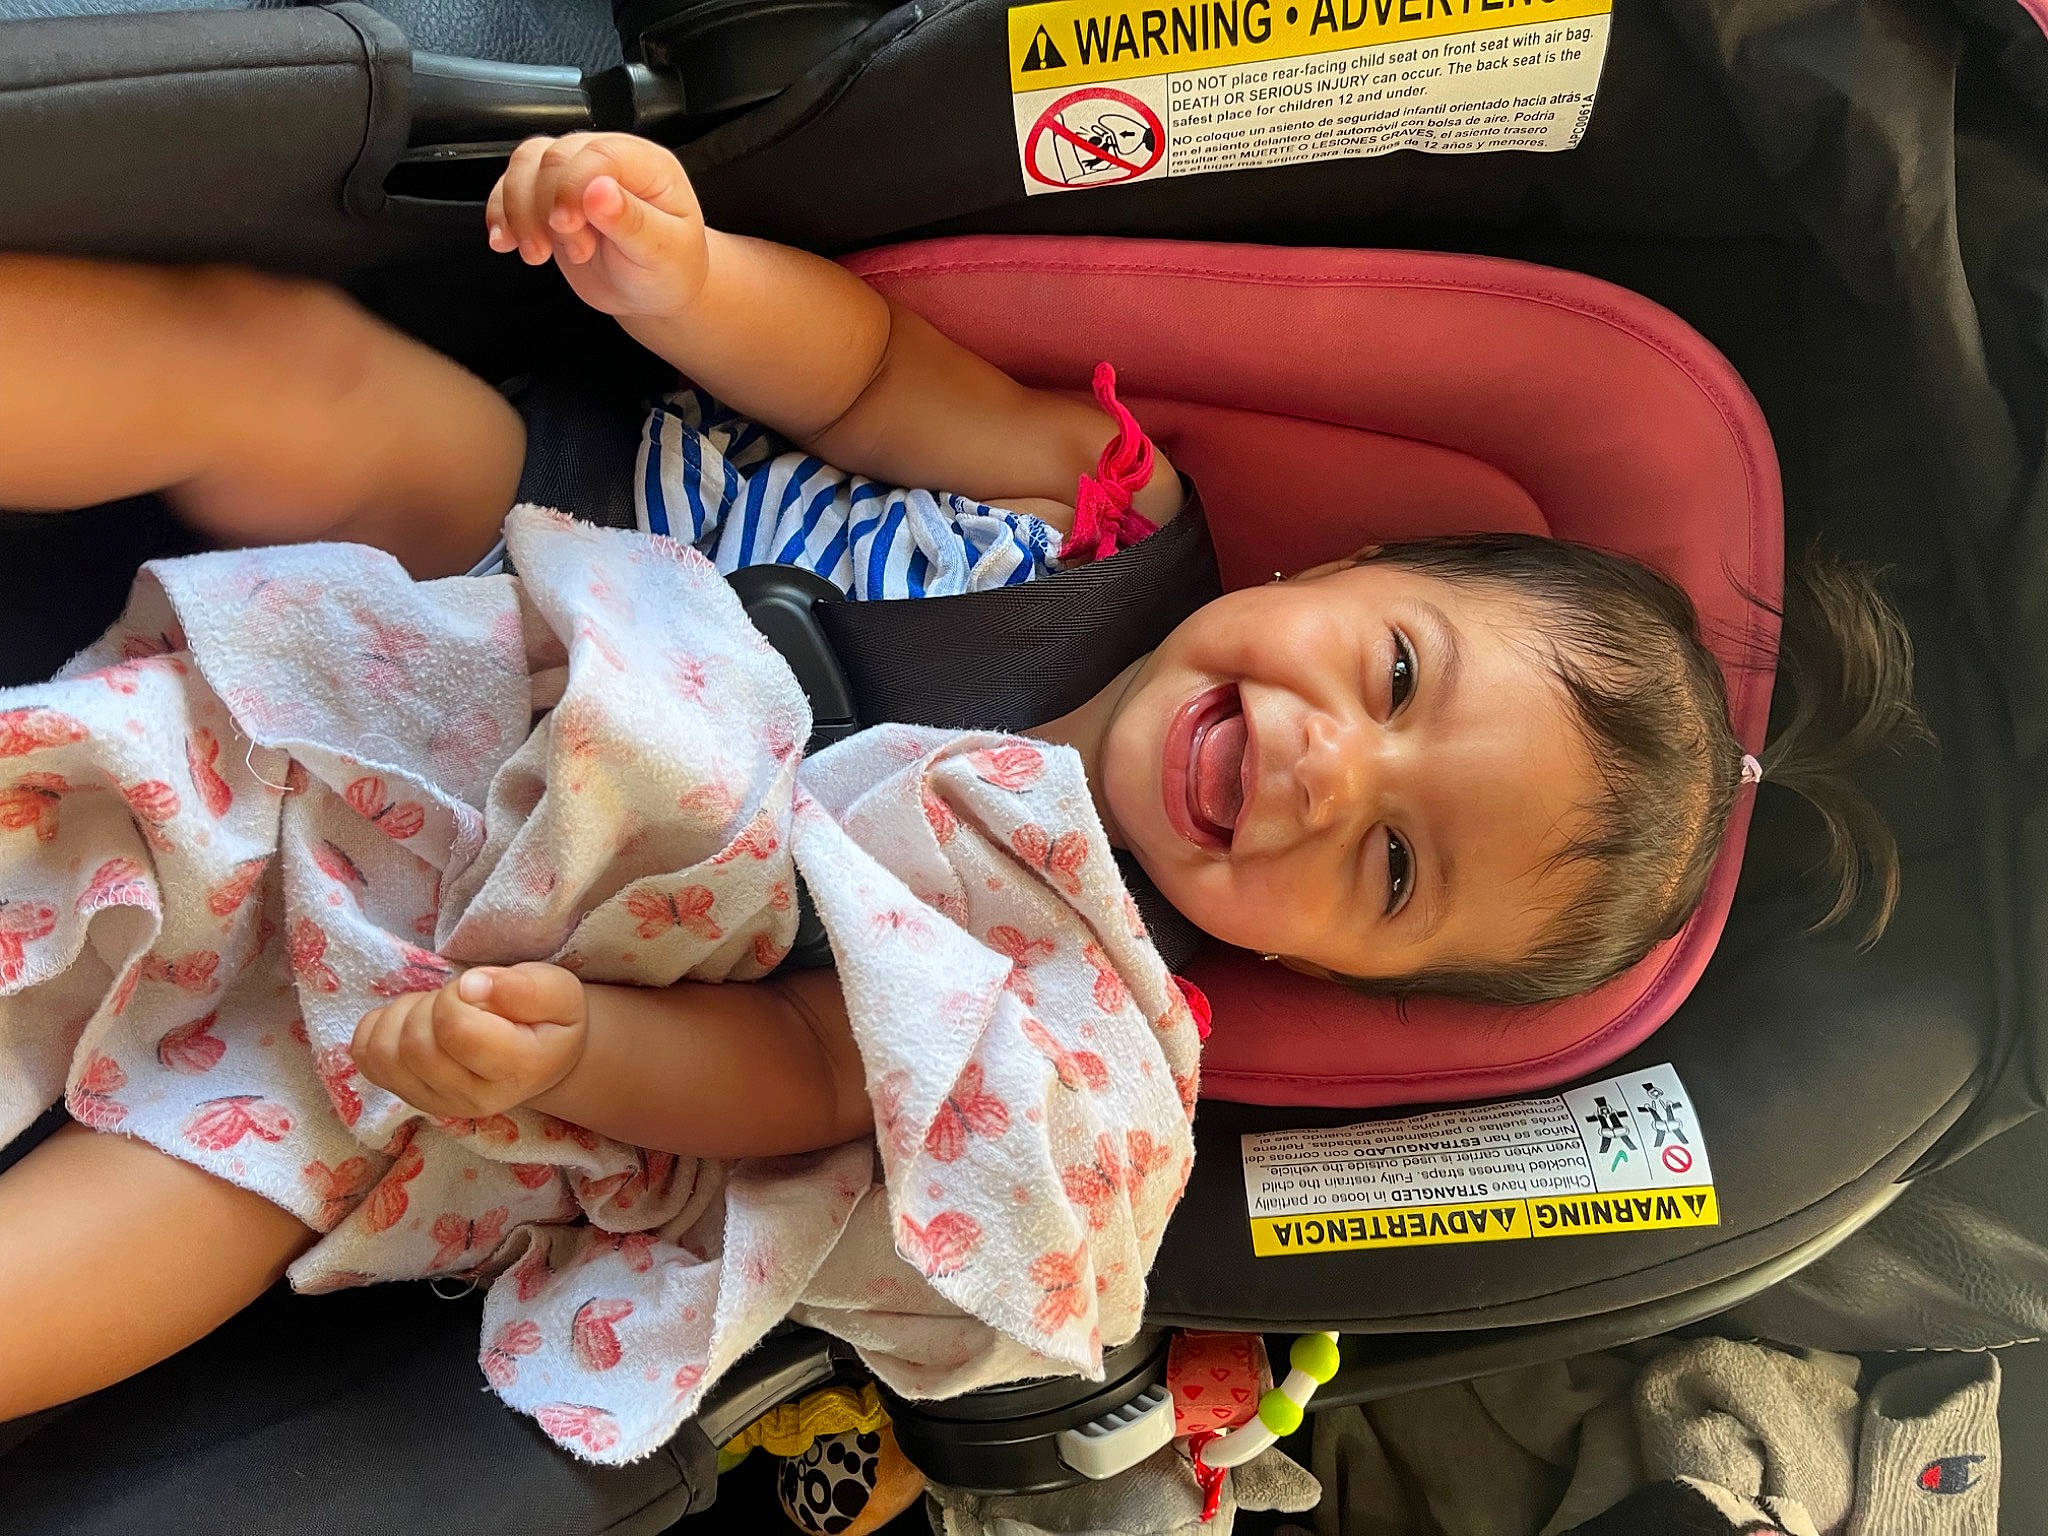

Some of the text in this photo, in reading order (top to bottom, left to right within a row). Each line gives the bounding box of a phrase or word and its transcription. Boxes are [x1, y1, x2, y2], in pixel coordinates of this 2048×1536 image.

[1073, 0, 1272, 65] WARNING
[1172, 27, 1593, 94] DO NOT place rear-facing child seat on front seat with air bag.
[1172, 48, 1581, 112] DEATH OR SERIOUS INJURY can occur. The back seat is the
[1172, 86, 1428, 127] safest place for children 12 and under.
[1173, 135, 1192, 146] NO
[1196, 130, 1246, 143] coloque
[1249, 127, 1265, 136] un
[1269, 120, 1314, 133] asiento
[1318, 117, 1333, 127] de
[1336, 108, 1400, 125] seguridad
[1403, 104, 1446, 116] infantil
[1449, 98, 1510, 113] orientado
[1550, 91, 1581, 104] atrás
[1172, 150, 1187, 158] en
[1190, 146, 1201, 155] el
[1204, 141, 1250, 153] asiento
[1253, 134, 1311, 147] delantero
[1314, 129, 1333, 139] del
[1401, 119, 1425, 127] con
[1427, 118, 1462, 128] bolsa
[1465, 115, 1481, 125] de
[1483, 114, 1510, 124] aire.
[1323, 1149, 1349, 1157] con
[1353, 1137, 1481, 1156] ESTRANGULADO
[1483, 1133, 1511, 1143] han
[1514, 1131, 1530, 1140] se
[1245, 1155, 1266, 1164] del
[1262, 1156, 1586, 1193] buckled harness straps. Fully restrain the child
[1266, 1141, 1580, 1176] even when carrier is used outside the vehicle.
[1269, 1151, 1320, 1162] correas
[1255, 1174, 1591, 1211] Children have STRANGLED in loose or partially
[1272, 1209, 1488, 1247] ADVERTENCIA
[1535, 1195, 1682, 1228] WARNING
